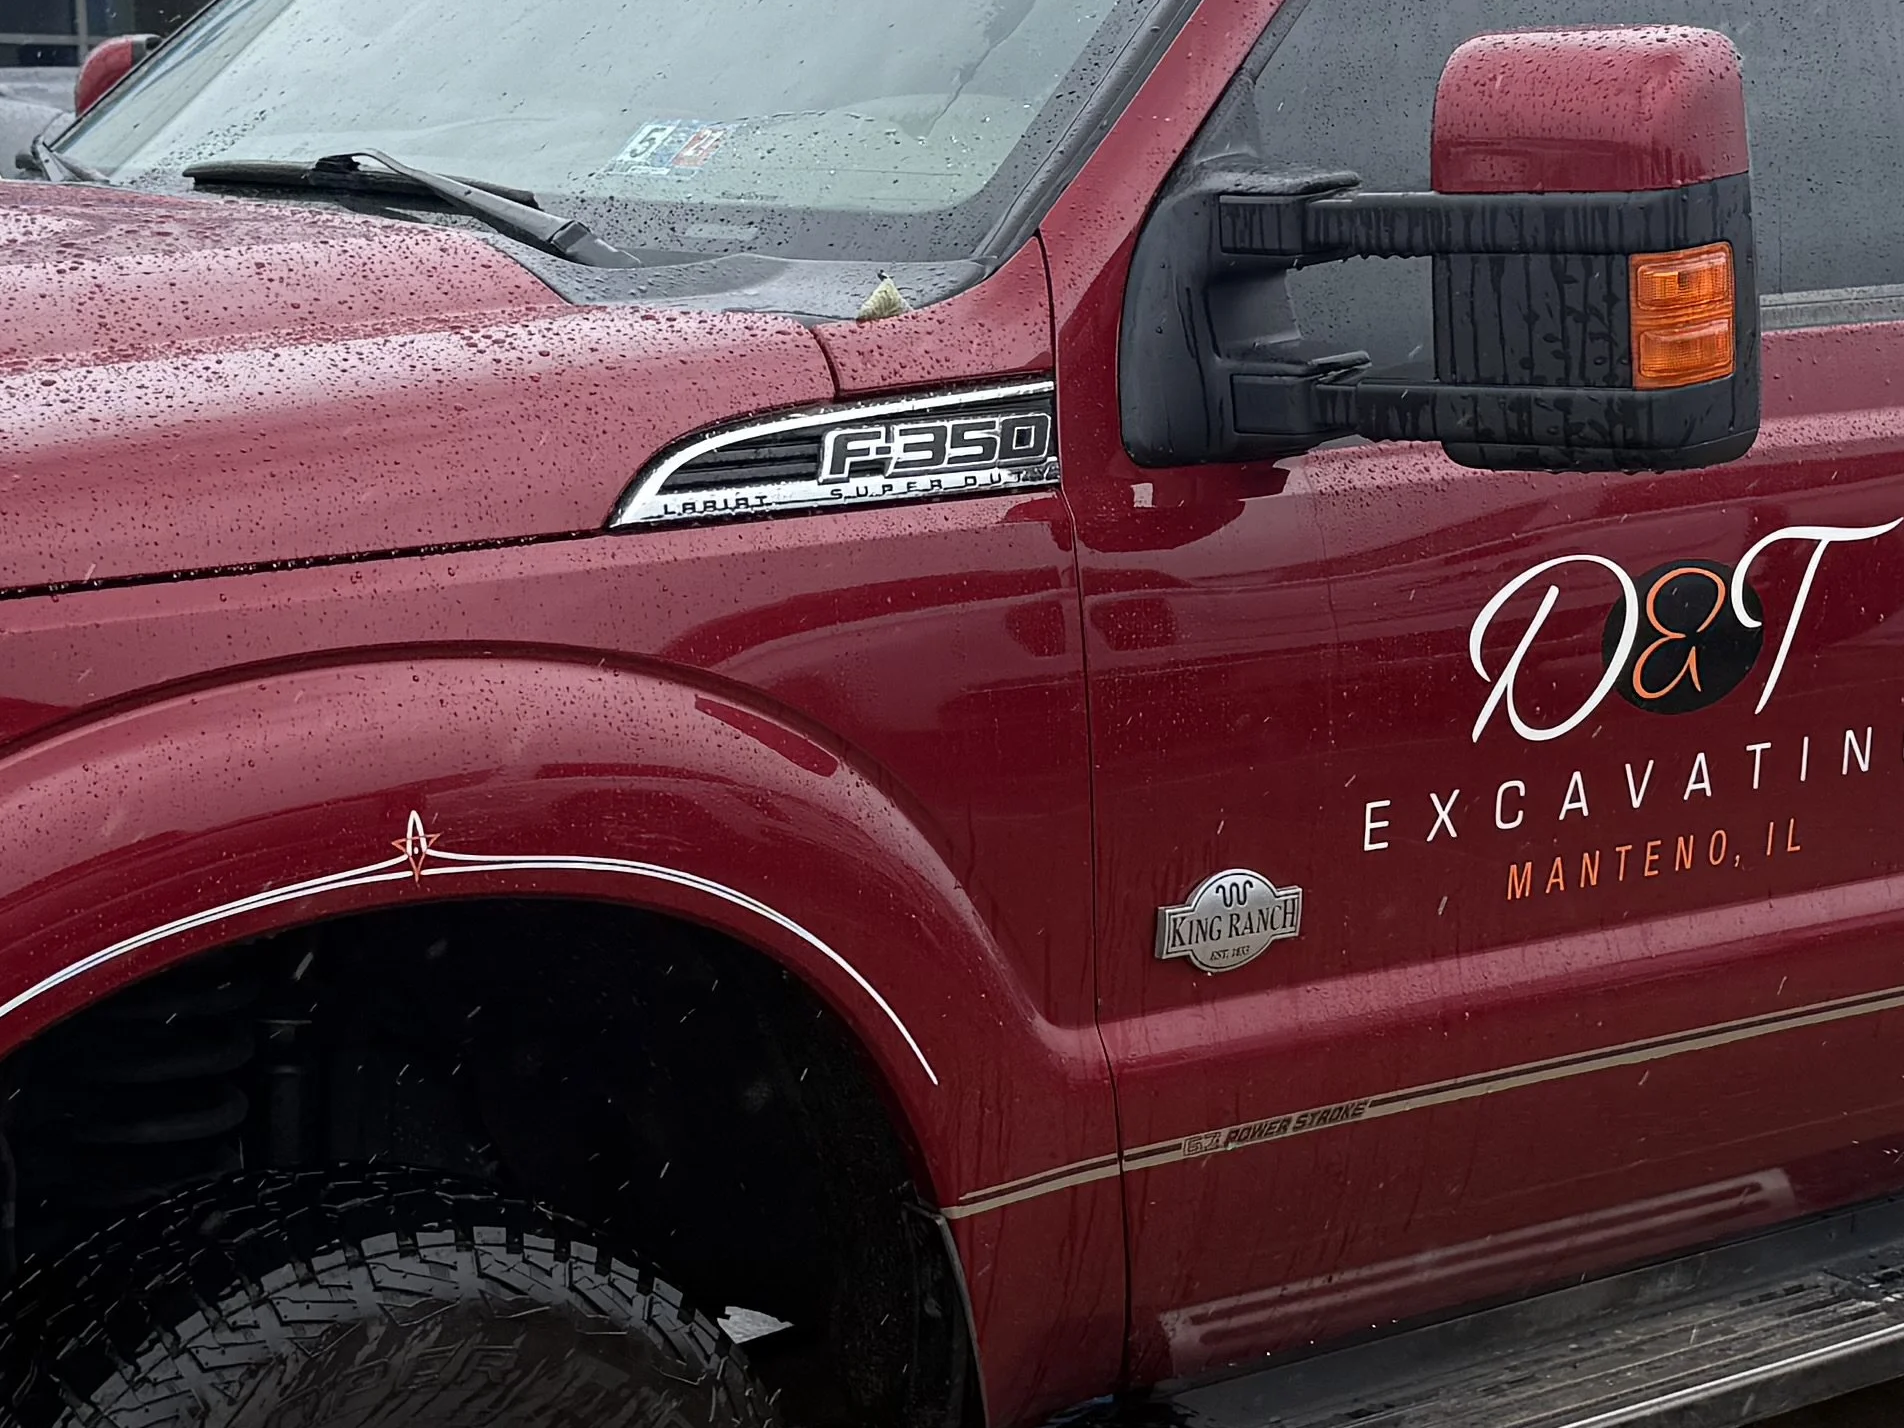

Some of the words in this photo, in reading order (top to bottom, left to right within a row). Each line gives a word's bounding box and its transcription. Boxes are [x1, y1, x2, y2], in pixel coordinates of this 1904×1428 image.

[824, 414, 1052, 483] F-350
[829, 478, 944, 501] SUPER
[1469, 517, 1904, 745] D&T
[1506, 829, 1742, 901] MANTENO,
[1765, 817, 1802, 855] IL
[1170, 916, 1222, 947] KING
[1228, 898, 1297, 939] RANCH
[1224, 1116, 1290, 1146] POWER
[1292, 1099, 1370, 1133] STROKE
